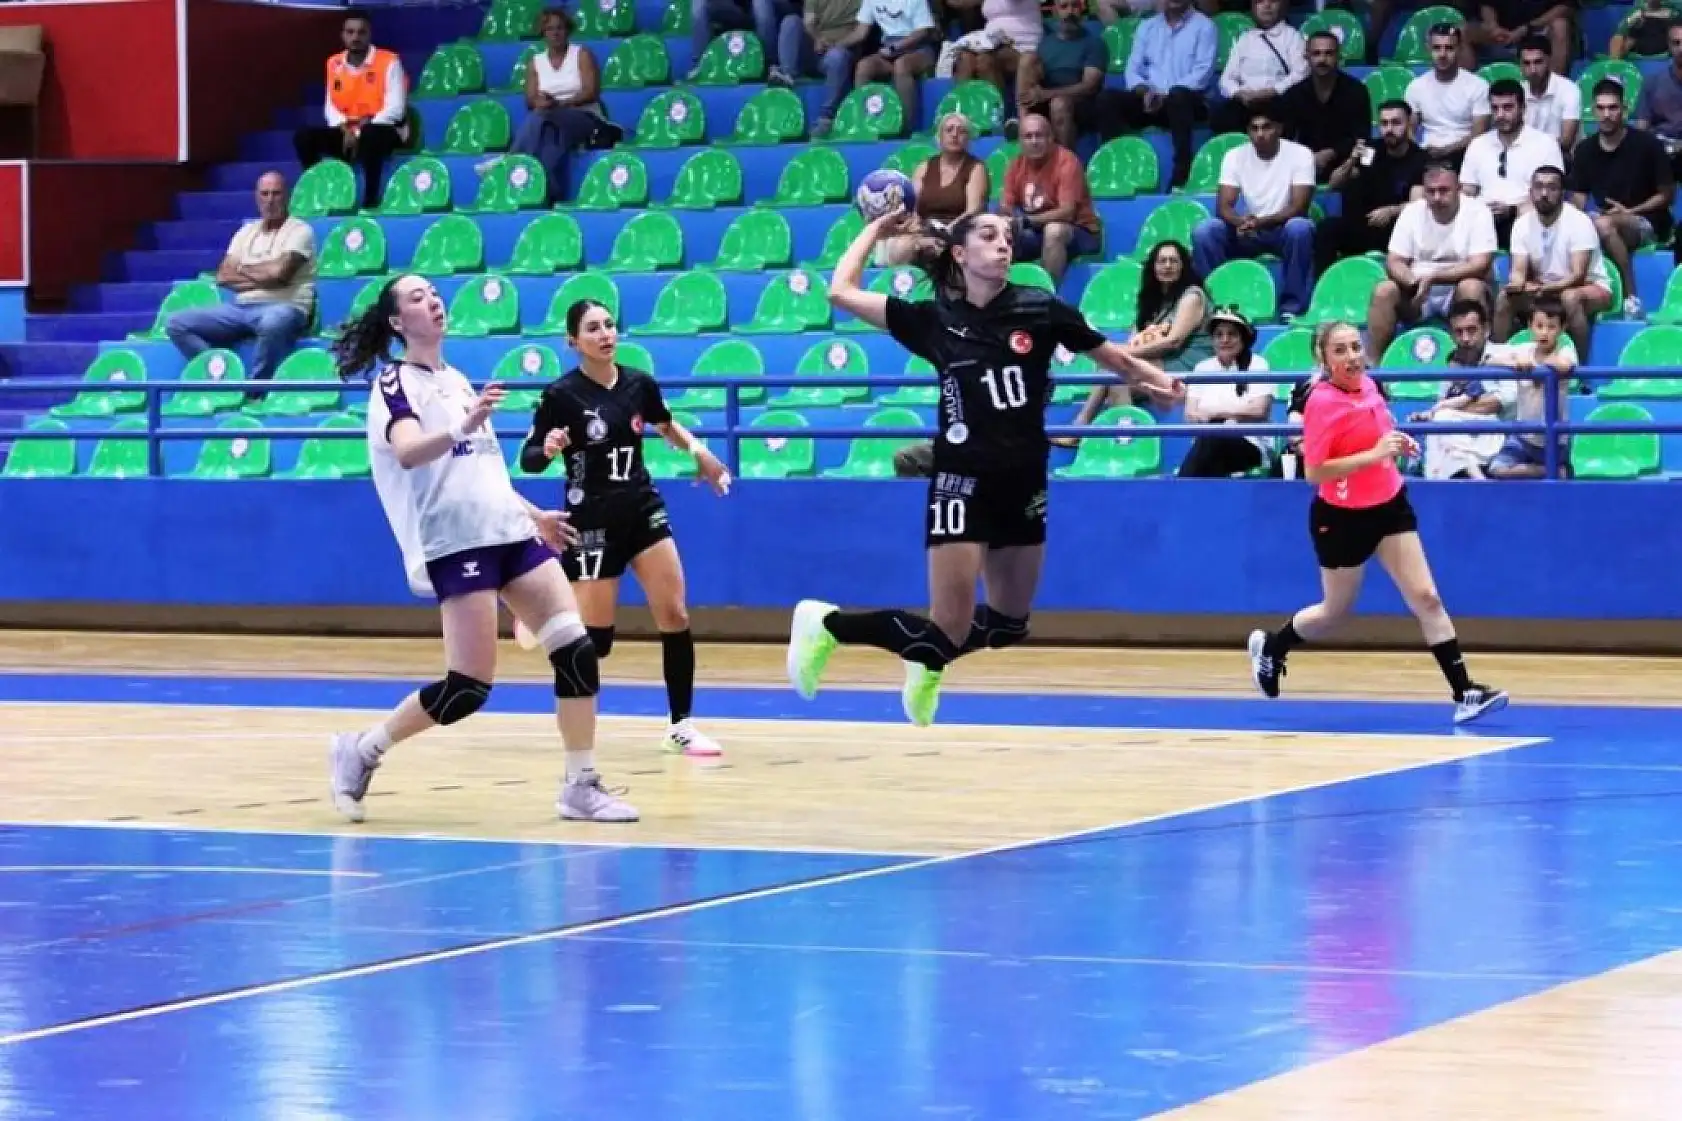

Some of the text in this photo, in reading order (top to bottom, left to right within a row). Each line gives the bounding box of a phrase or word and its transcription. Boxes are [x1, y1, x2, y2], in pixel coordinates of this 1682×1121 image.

[980, 365, 1028, 410] 10
[452, 439, 474, 459] MC
[607, 446, 635, 481] 17
[929, 499, 966, 535] 10
[576, 549, 604, 581] 17
